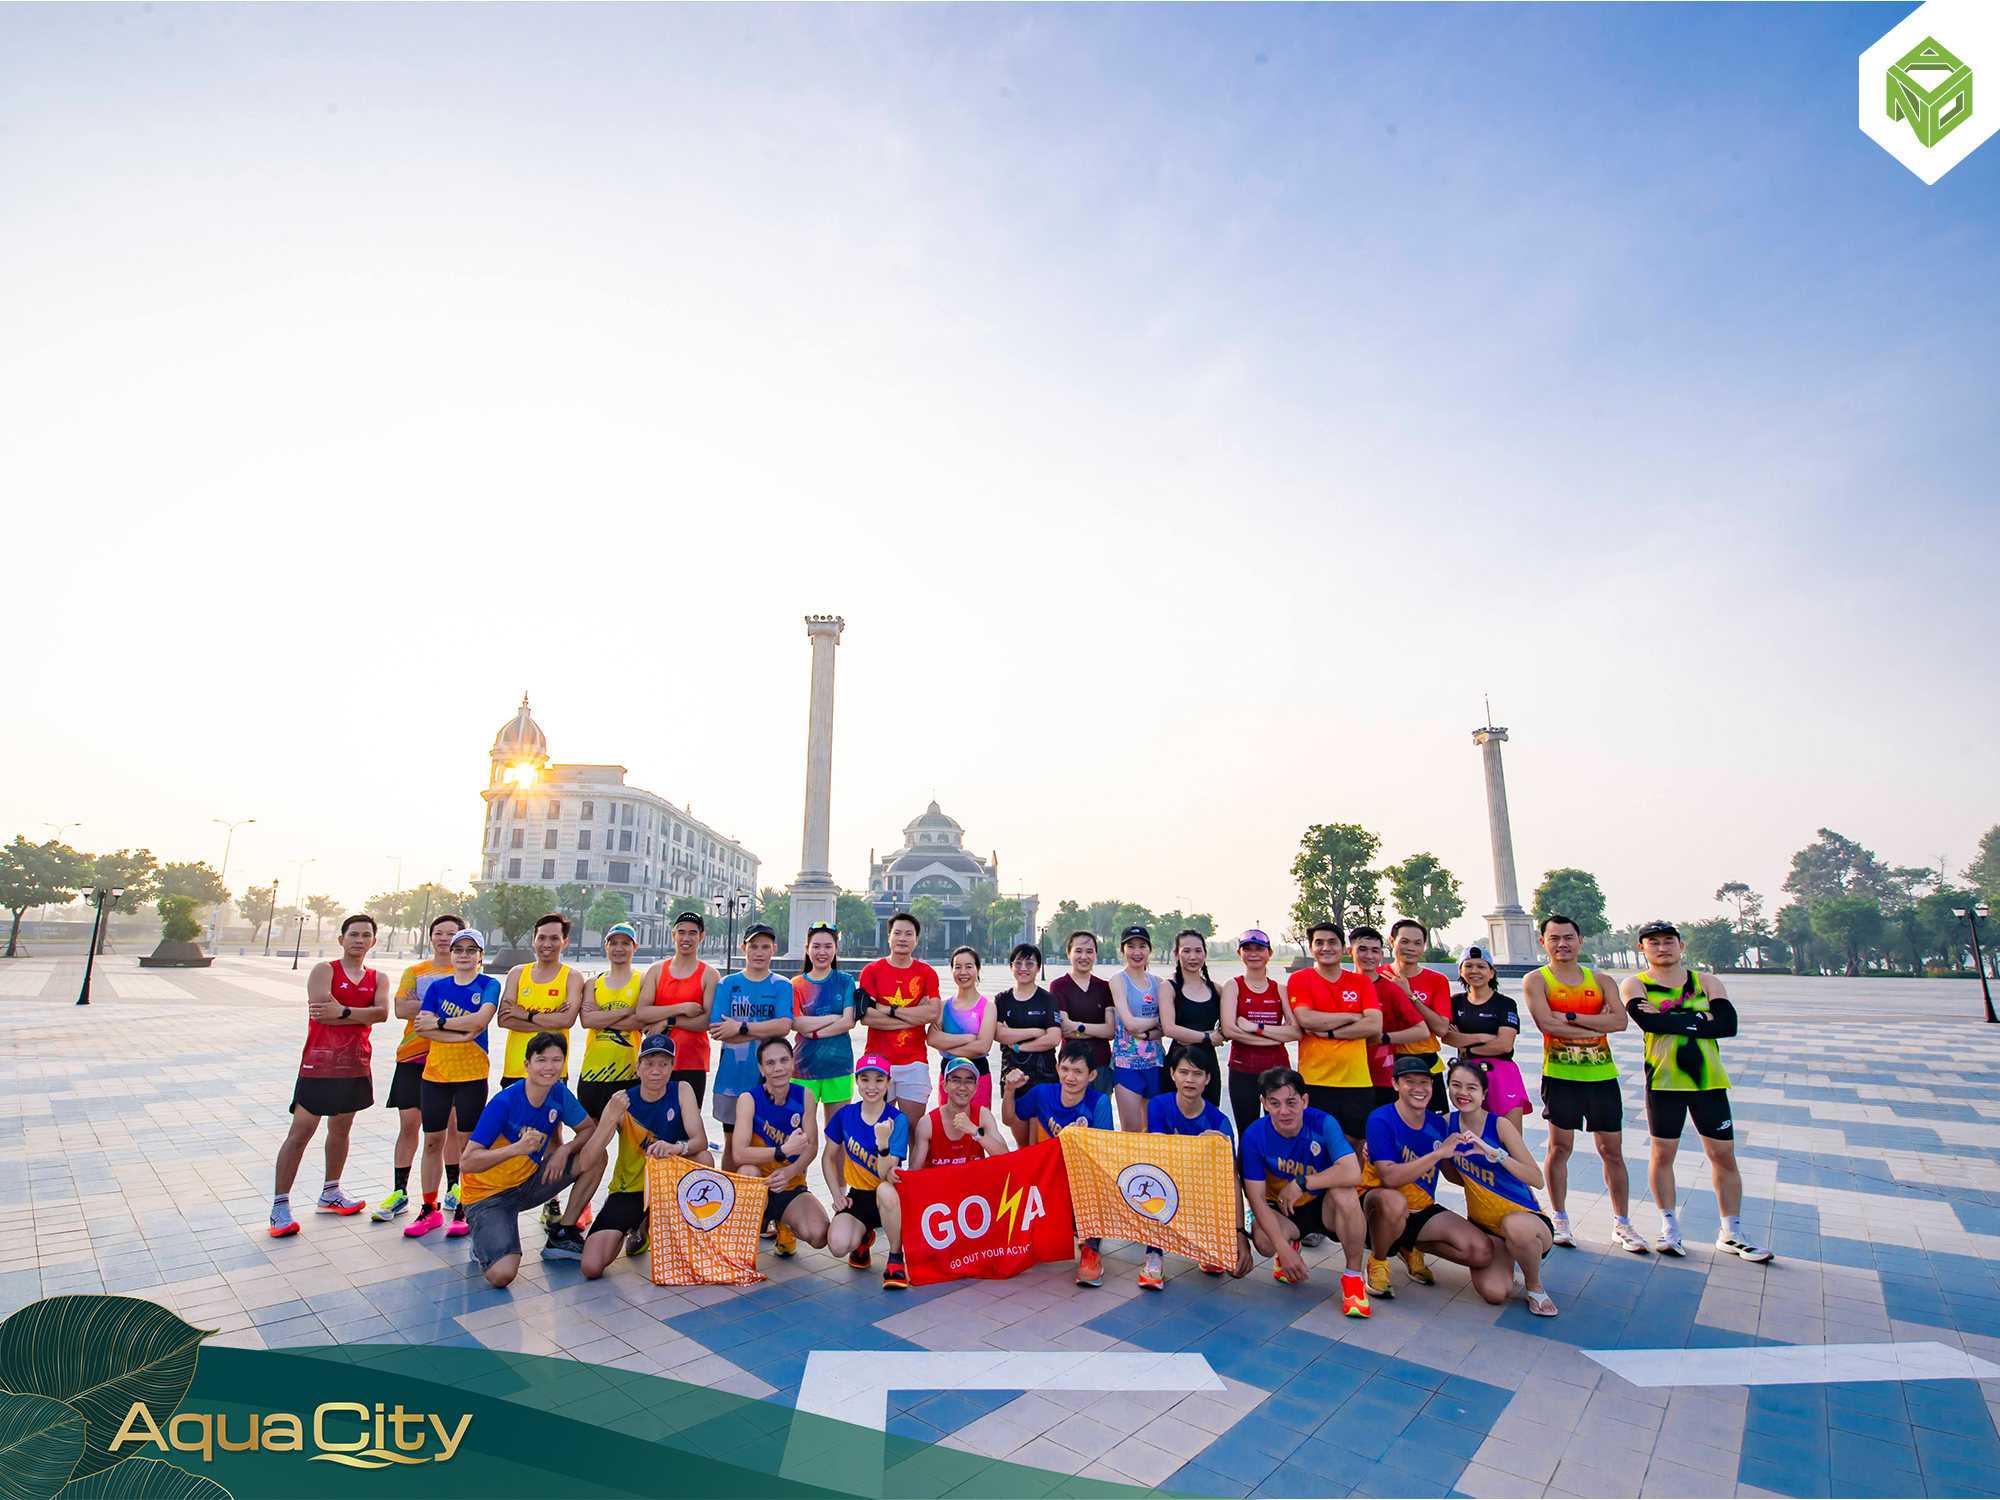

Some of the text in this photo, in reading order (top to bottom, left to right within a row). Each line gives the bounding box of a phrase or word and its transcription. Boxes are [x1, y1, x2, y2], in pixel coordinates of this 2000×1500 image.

[732, 1003, 775, 1018] FINISHER
[950, 1242, 1032, 1270] GO OUT YOUR ACTI
